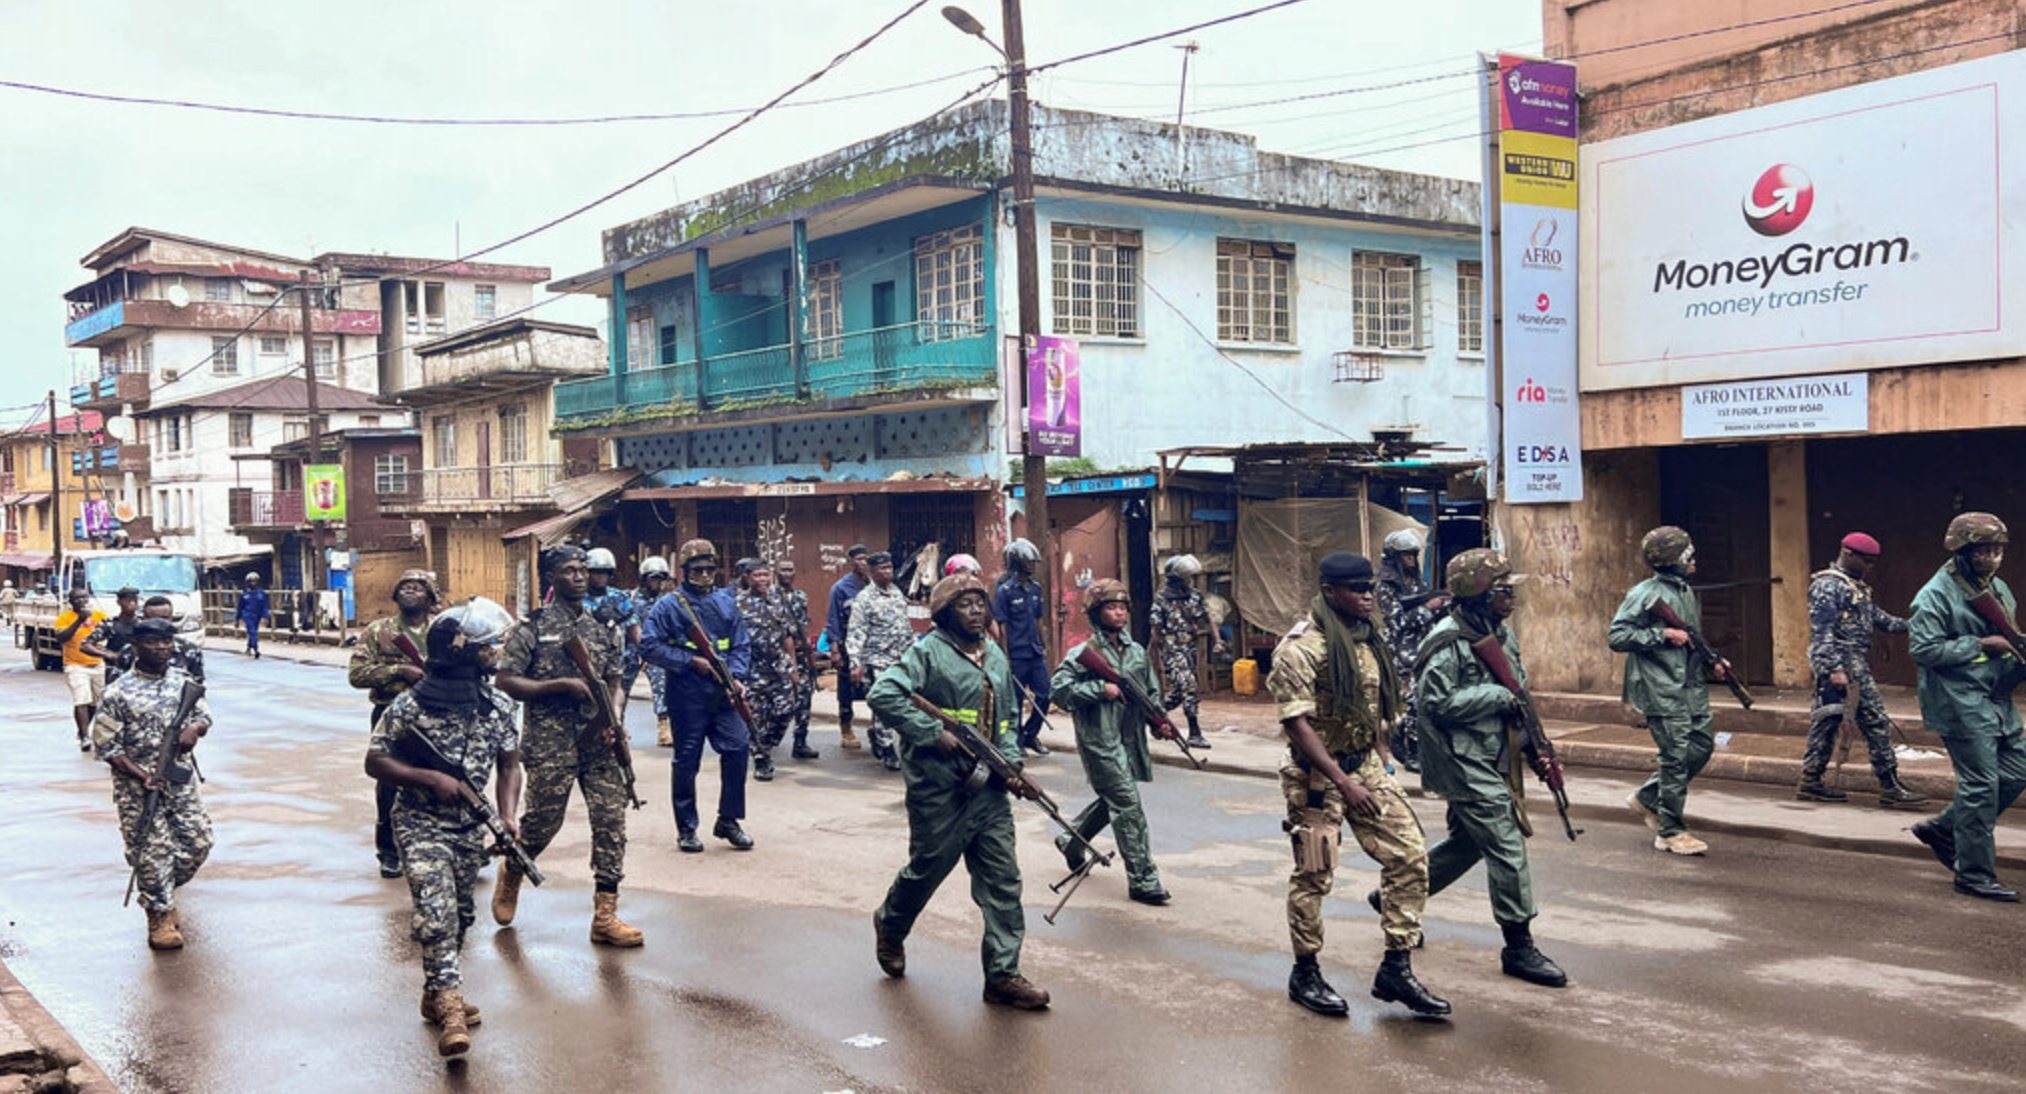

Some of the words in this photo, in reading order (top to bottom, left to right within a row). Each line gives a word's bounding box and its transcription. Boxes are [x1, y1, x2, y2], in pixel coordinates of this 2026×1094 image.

[1507, 156, 1548, 167] WESTERN
[1520, 165, 1548, 175] UNION
[1522, 248, 1562, 265] AFRO
[1653, 236, 1909, 294] MoneyGram
[1684, 294, 1765, 318] money
[1766, 281, 1868, 311] transfer
[1517, 313, 1567, 326] MoneyGram
[1517, 377, 1545, 403] ria
[1692, 388, 1730, 405] AFRO
[1732, 381, 1853, 403] INTERNATIONAL
[1717, 408, 1729, 417] 1ST
[1762, 406, 1773, 416] 27
[1799, 403, 1824, 413] ROAD
